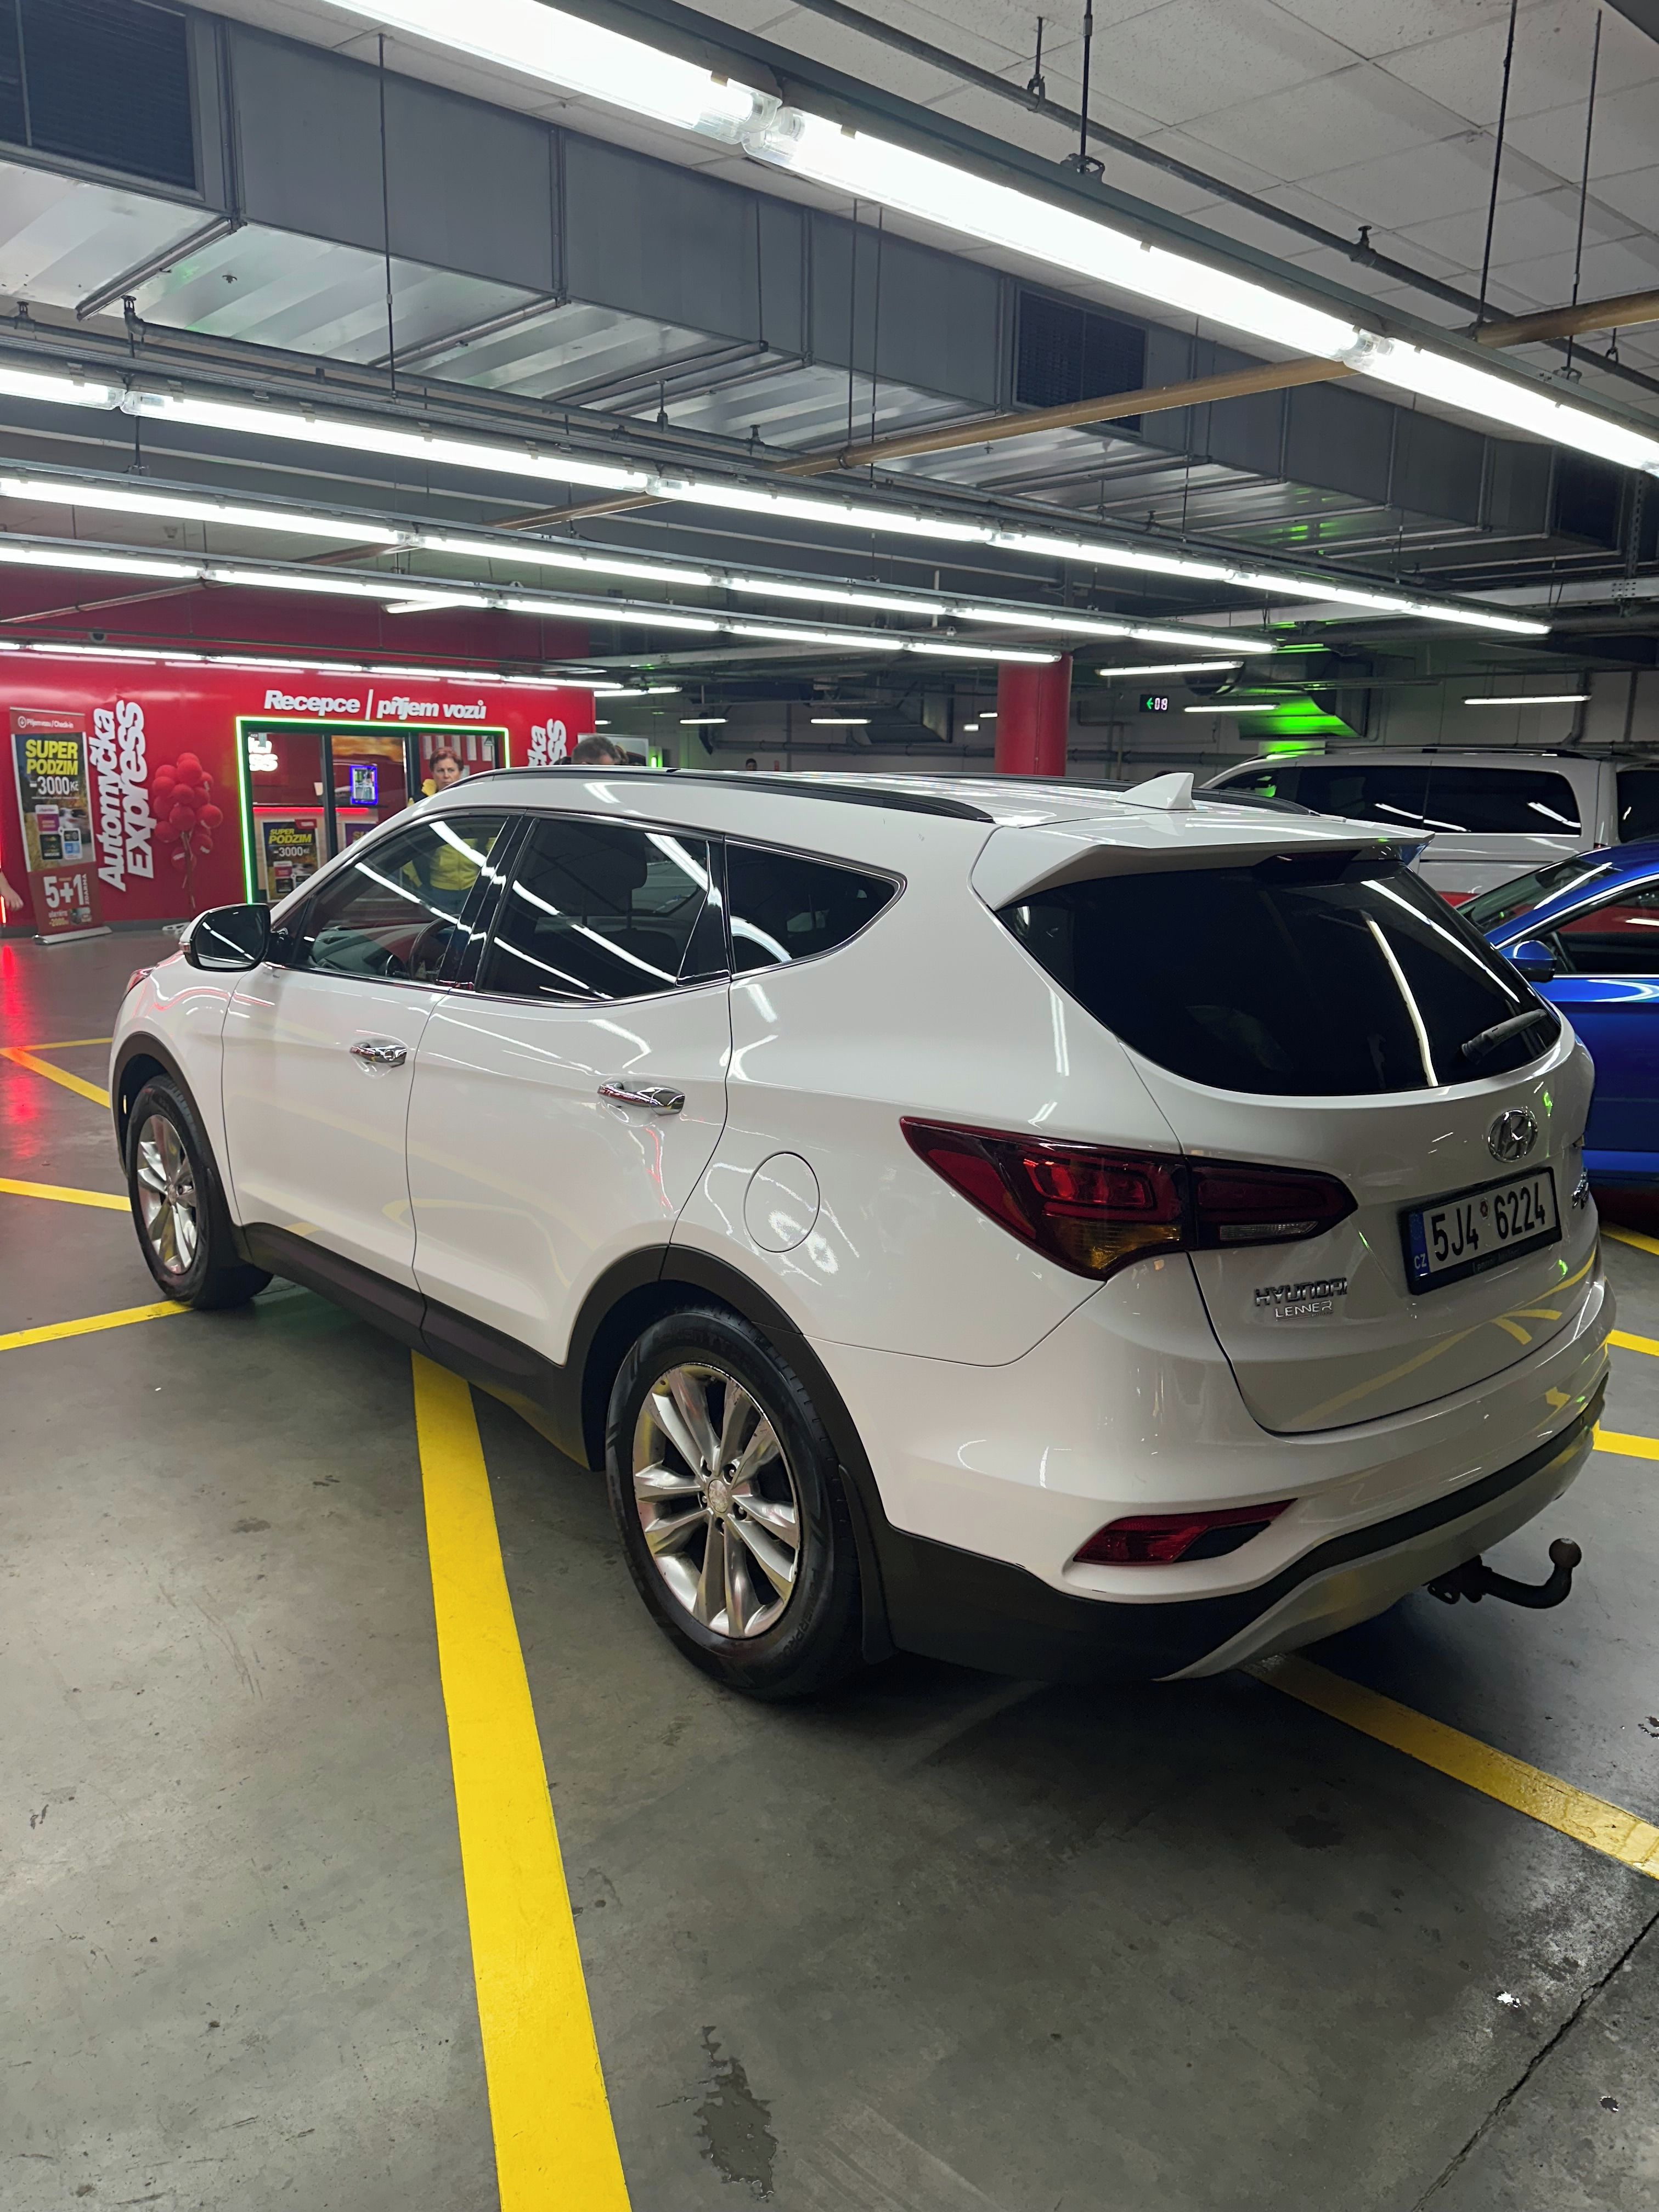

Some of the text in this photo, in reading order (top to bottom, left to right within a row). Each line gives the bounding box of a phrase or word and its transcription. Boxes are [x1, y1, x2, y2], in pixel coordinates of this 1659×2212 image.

[264, 690, 360, 716] Recepce
[376, 696, 439, 720] příjem
[443, 699, 487, 719] vozů
[1154, 697, 1168, 710] 08
[25, 739, 78, 759] SUPER
[26, 759, 78, 775] PODZIM
[89, 708, 126, 891] Automyčka
[116, 700, 157, 878] Express
[268, 834, 312, 844] PODZIM
[43, 874, 84, 909] 5+1
[1431, 1204, 1479, 1261] 5J4
[1494, 1182, 1545, 1239] 6224
[1414, 1253, 1427, 1269] CZ
[1255, 1277, 1348, 1306] HYUNDAI
[1275, 1300, 1333, 1317] LENNER
